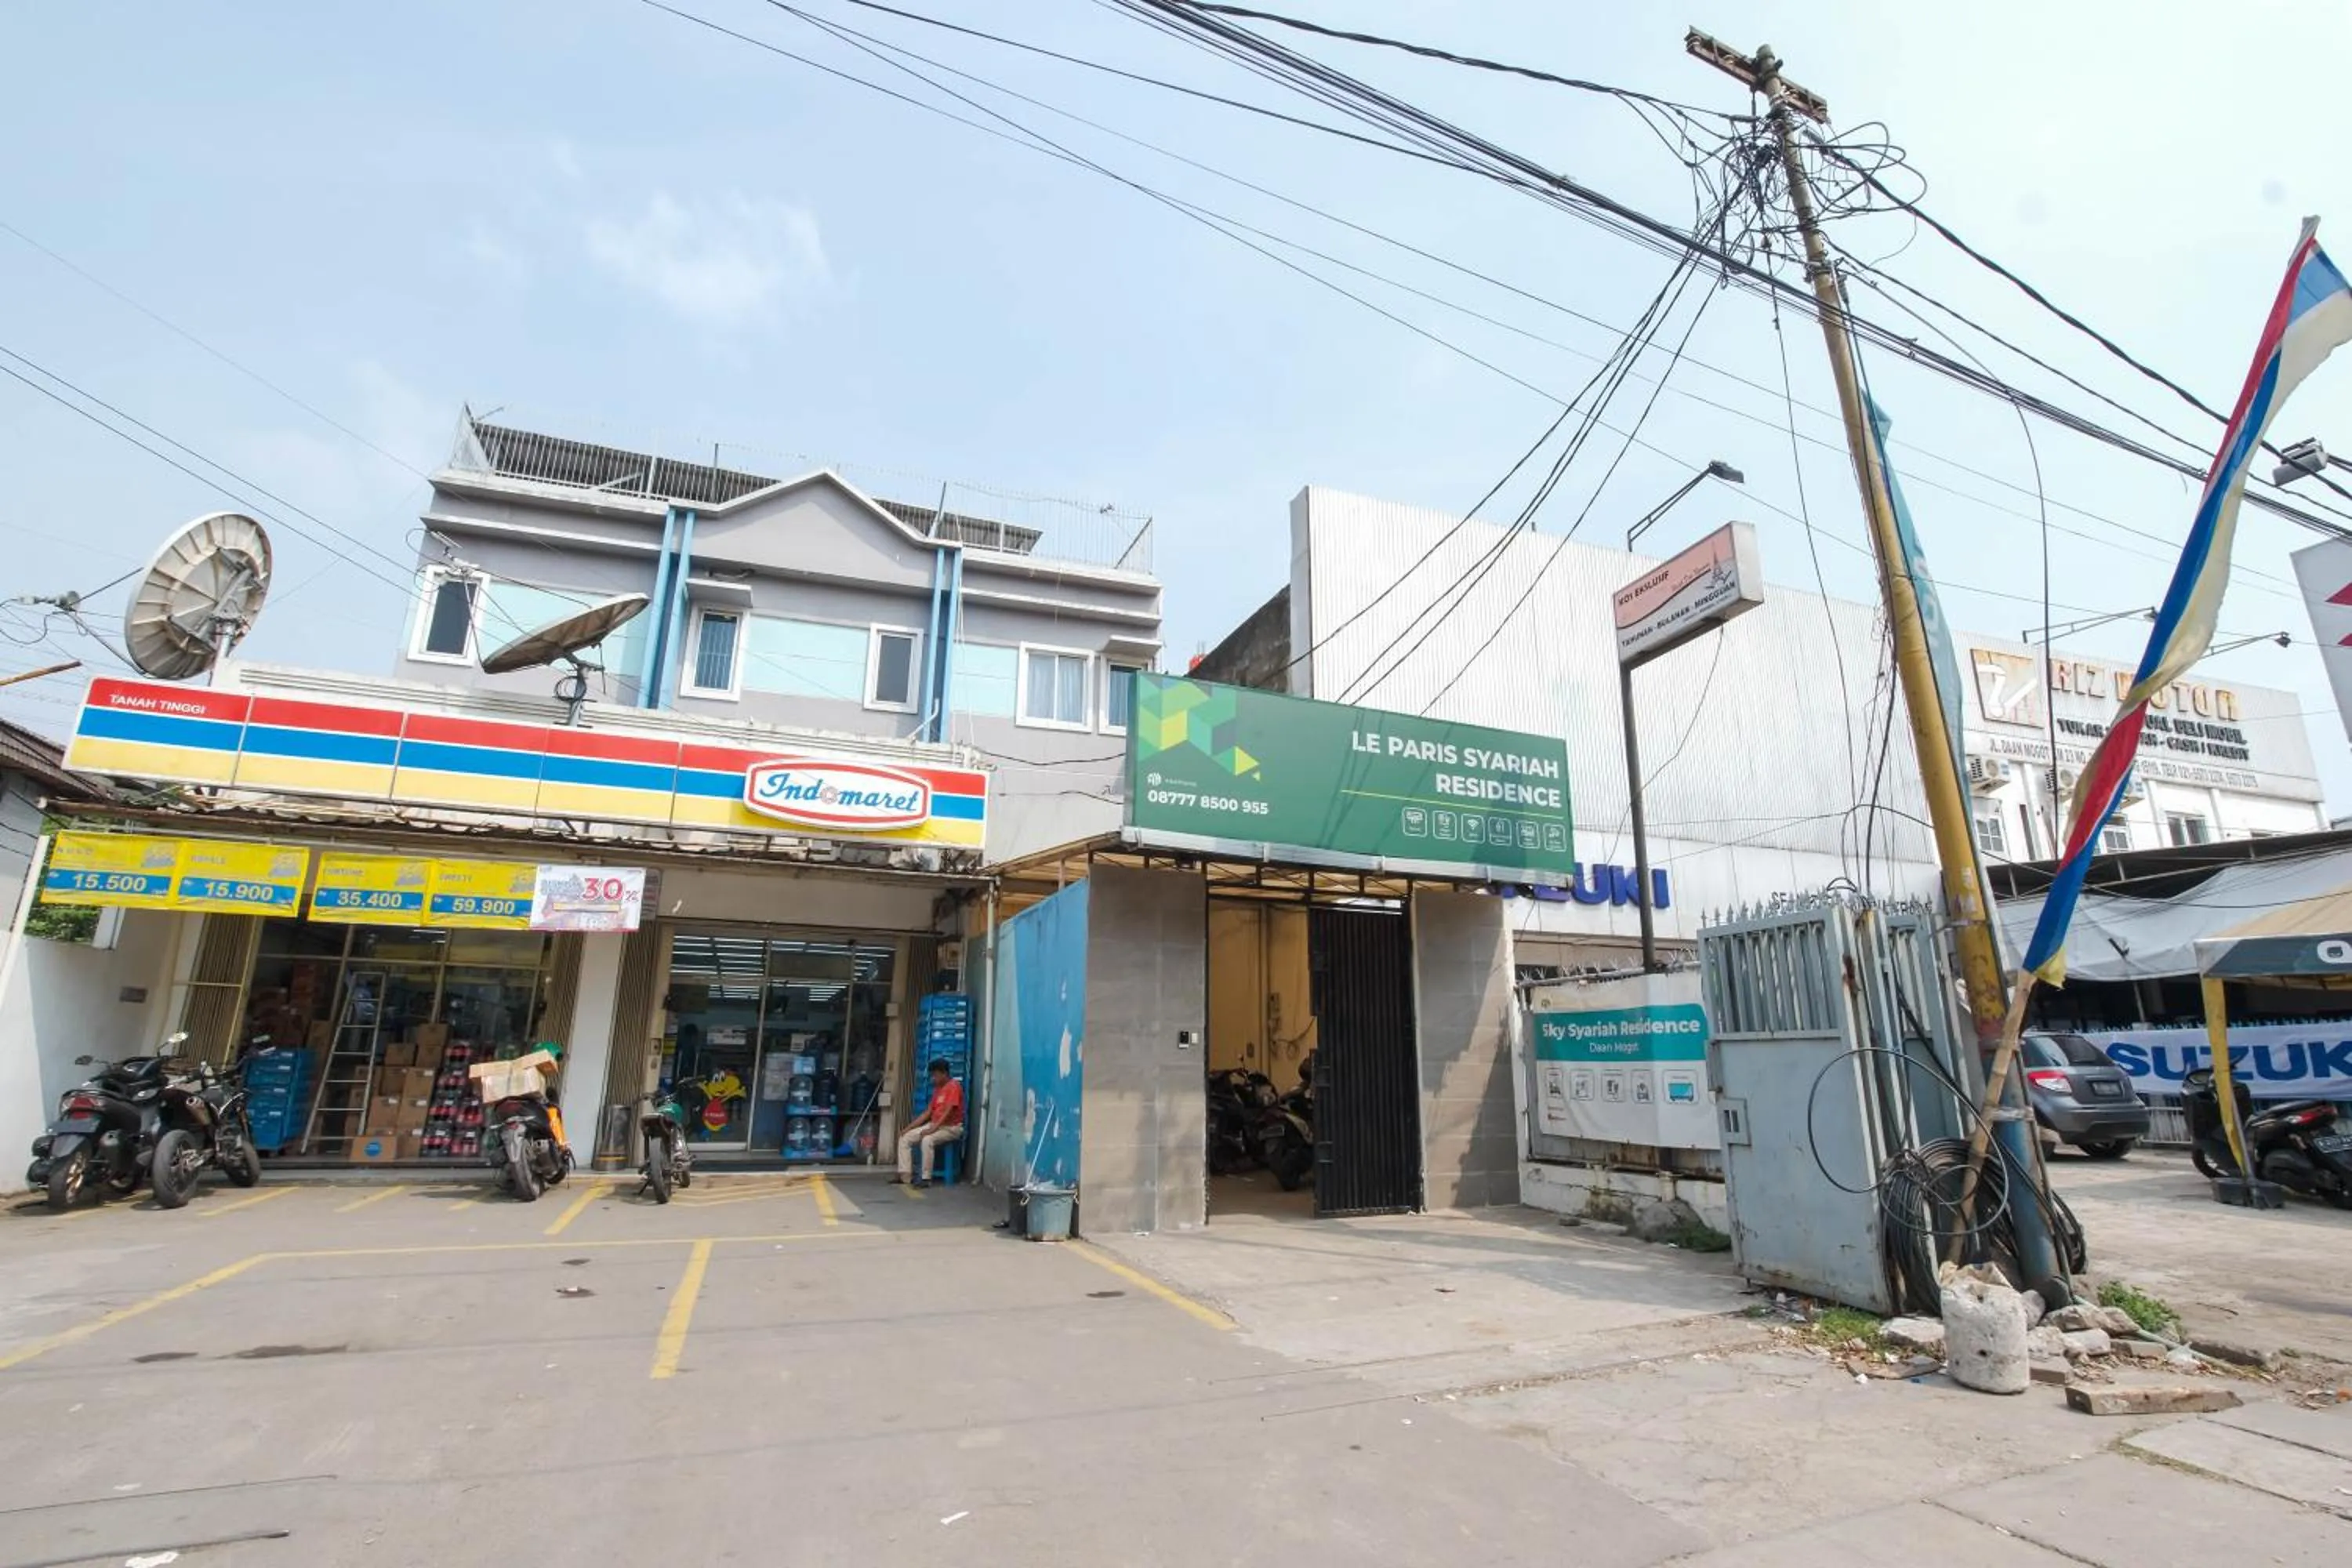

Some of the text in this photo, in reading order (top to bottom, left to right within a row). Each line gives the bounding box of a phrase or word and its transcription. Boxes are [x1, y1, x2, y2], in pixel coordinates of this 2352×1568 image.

[1694, 581, 1735, 608] MINGGUAN
[109, 694, 207, 714] TANAH TINGGI
[2057, 717, 2105, 738] TUKAR
[2166, 736, 2200, 753] CASH
[2144, 714, 2248, 745] UAL BELI MOBIL
[1352, 731, 1559, 779] LE PARIS SYARIAH
[758, 772, 919, 811] Indomaret
[1147, 789, 1269, 815] 08777 8500 955
[1436, 773, 1562, 808] RESIDENCE
[72, 873, 147, 891] 15.500
[205, 880, 274, 901] 15.900
[337, 890, 401, 908] 35.400
[452, 897, 515, 916] 59.900
[1542, 1018, 1700, 1040] Sky Syariah Residence
[1589, 1042, 1612, 1053] Daan
